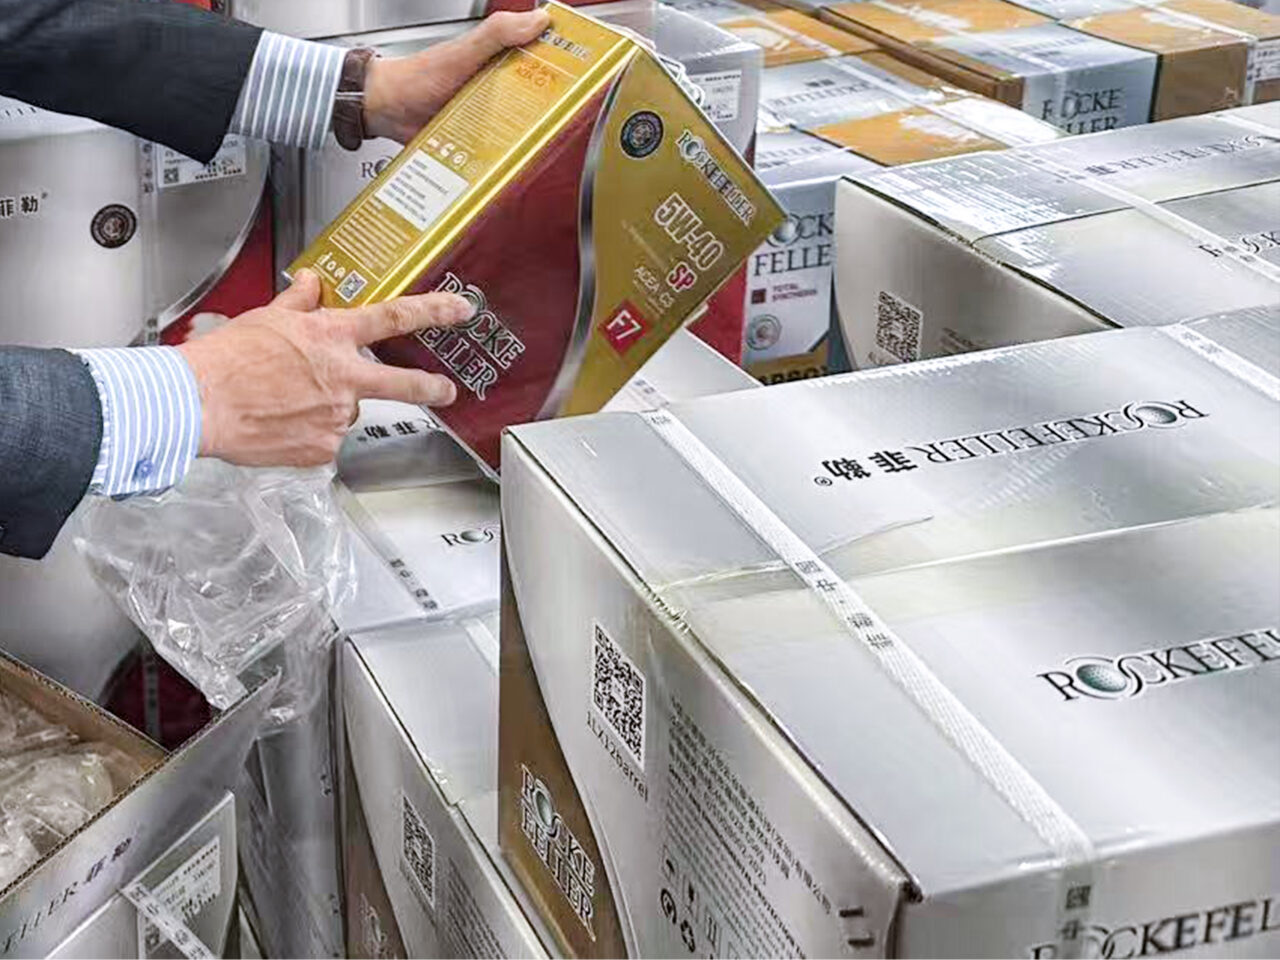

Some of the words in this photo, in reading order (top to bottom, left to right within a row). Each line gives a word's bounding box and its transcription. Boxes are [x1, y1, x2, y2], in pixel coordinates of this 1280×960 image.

[676, 129, 758, 227] ROCKEFELLER
[653, 192, 724, 271] 5W-40
[666, 262, 697, 292] SP
[607, 309, 642, 340] F7
[413, 323, 497, 401] ELLER
[913, 400, 1210, 464] ROCKEFELLER
